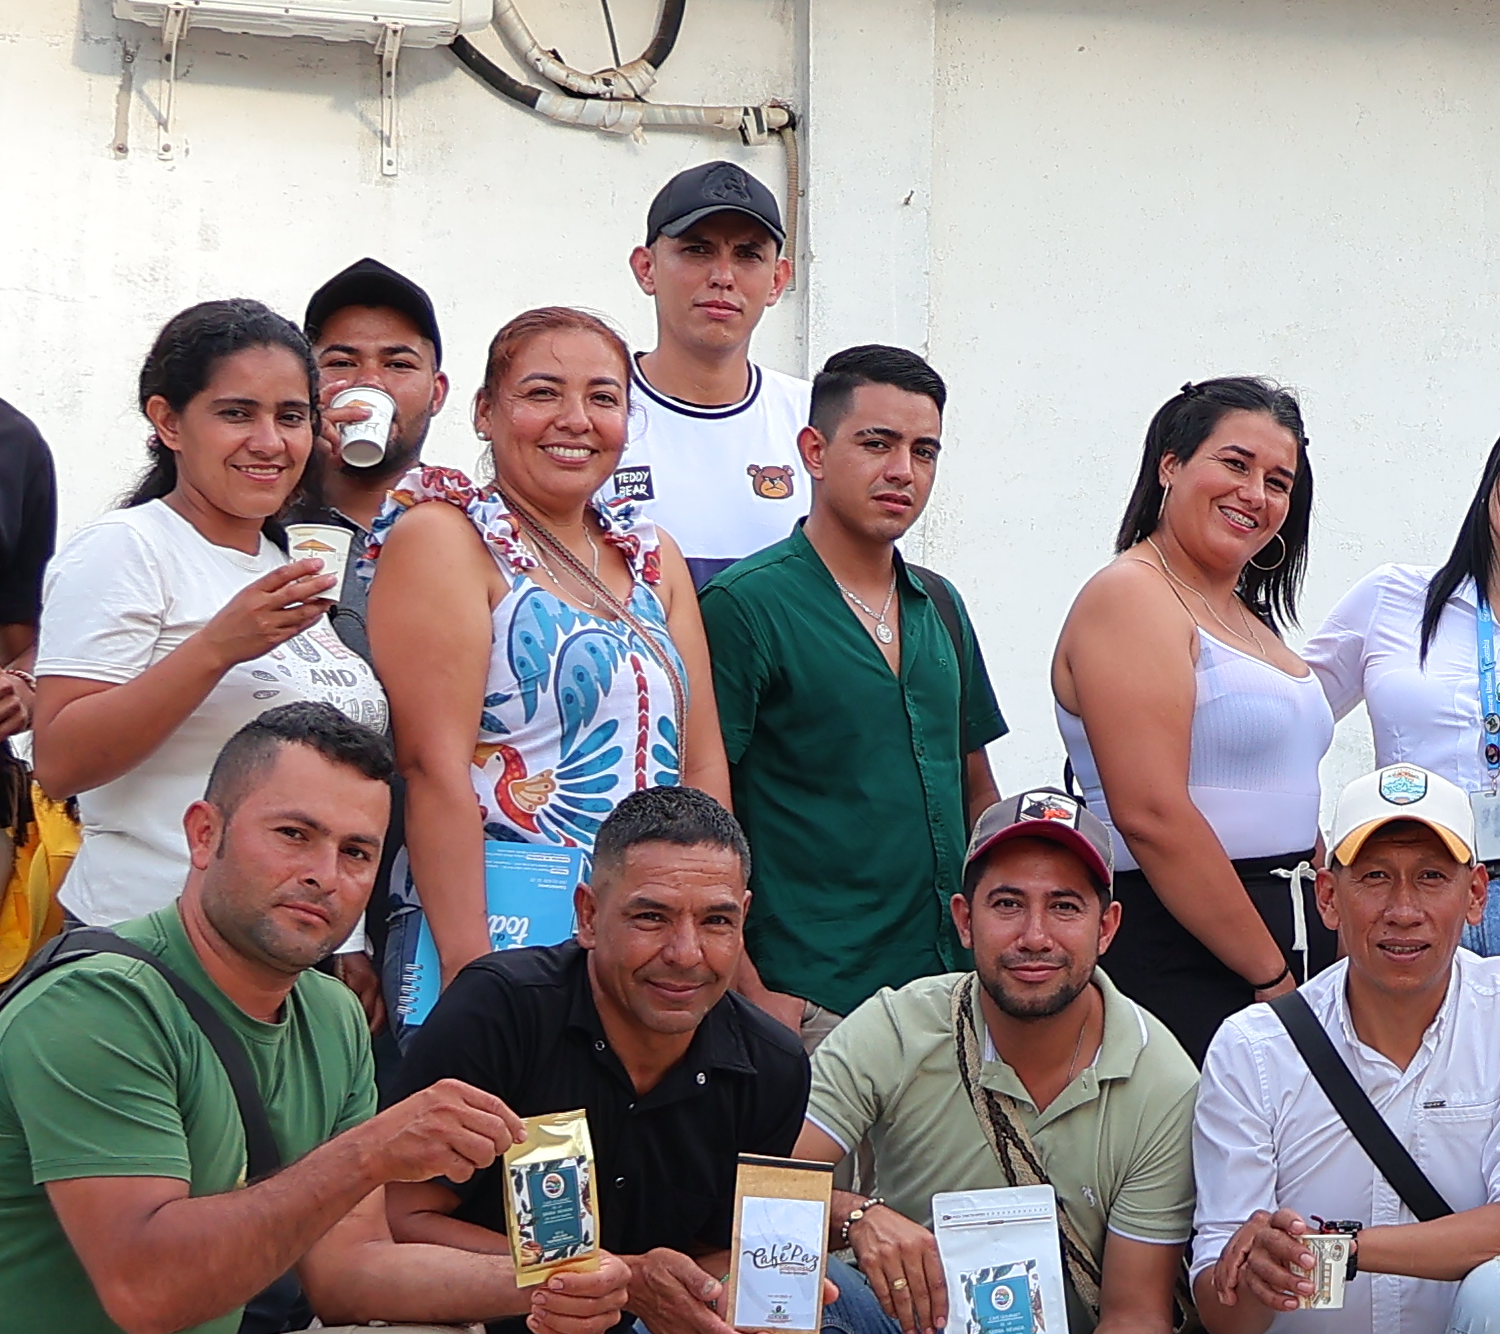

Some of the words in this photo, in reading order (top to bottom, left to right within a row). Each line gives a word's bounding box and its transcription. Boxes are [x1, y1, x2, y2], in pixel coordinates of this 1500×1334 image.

[615, 471, 649, 485] TEDDY
[619, 484, 649, 496] BEAR
[310, 668, 358, 687] AND
[488, 915, 529, 945] tod
[743, 1242, 790, 1269] Café
[791, 1244, 819, 1272] Paz
